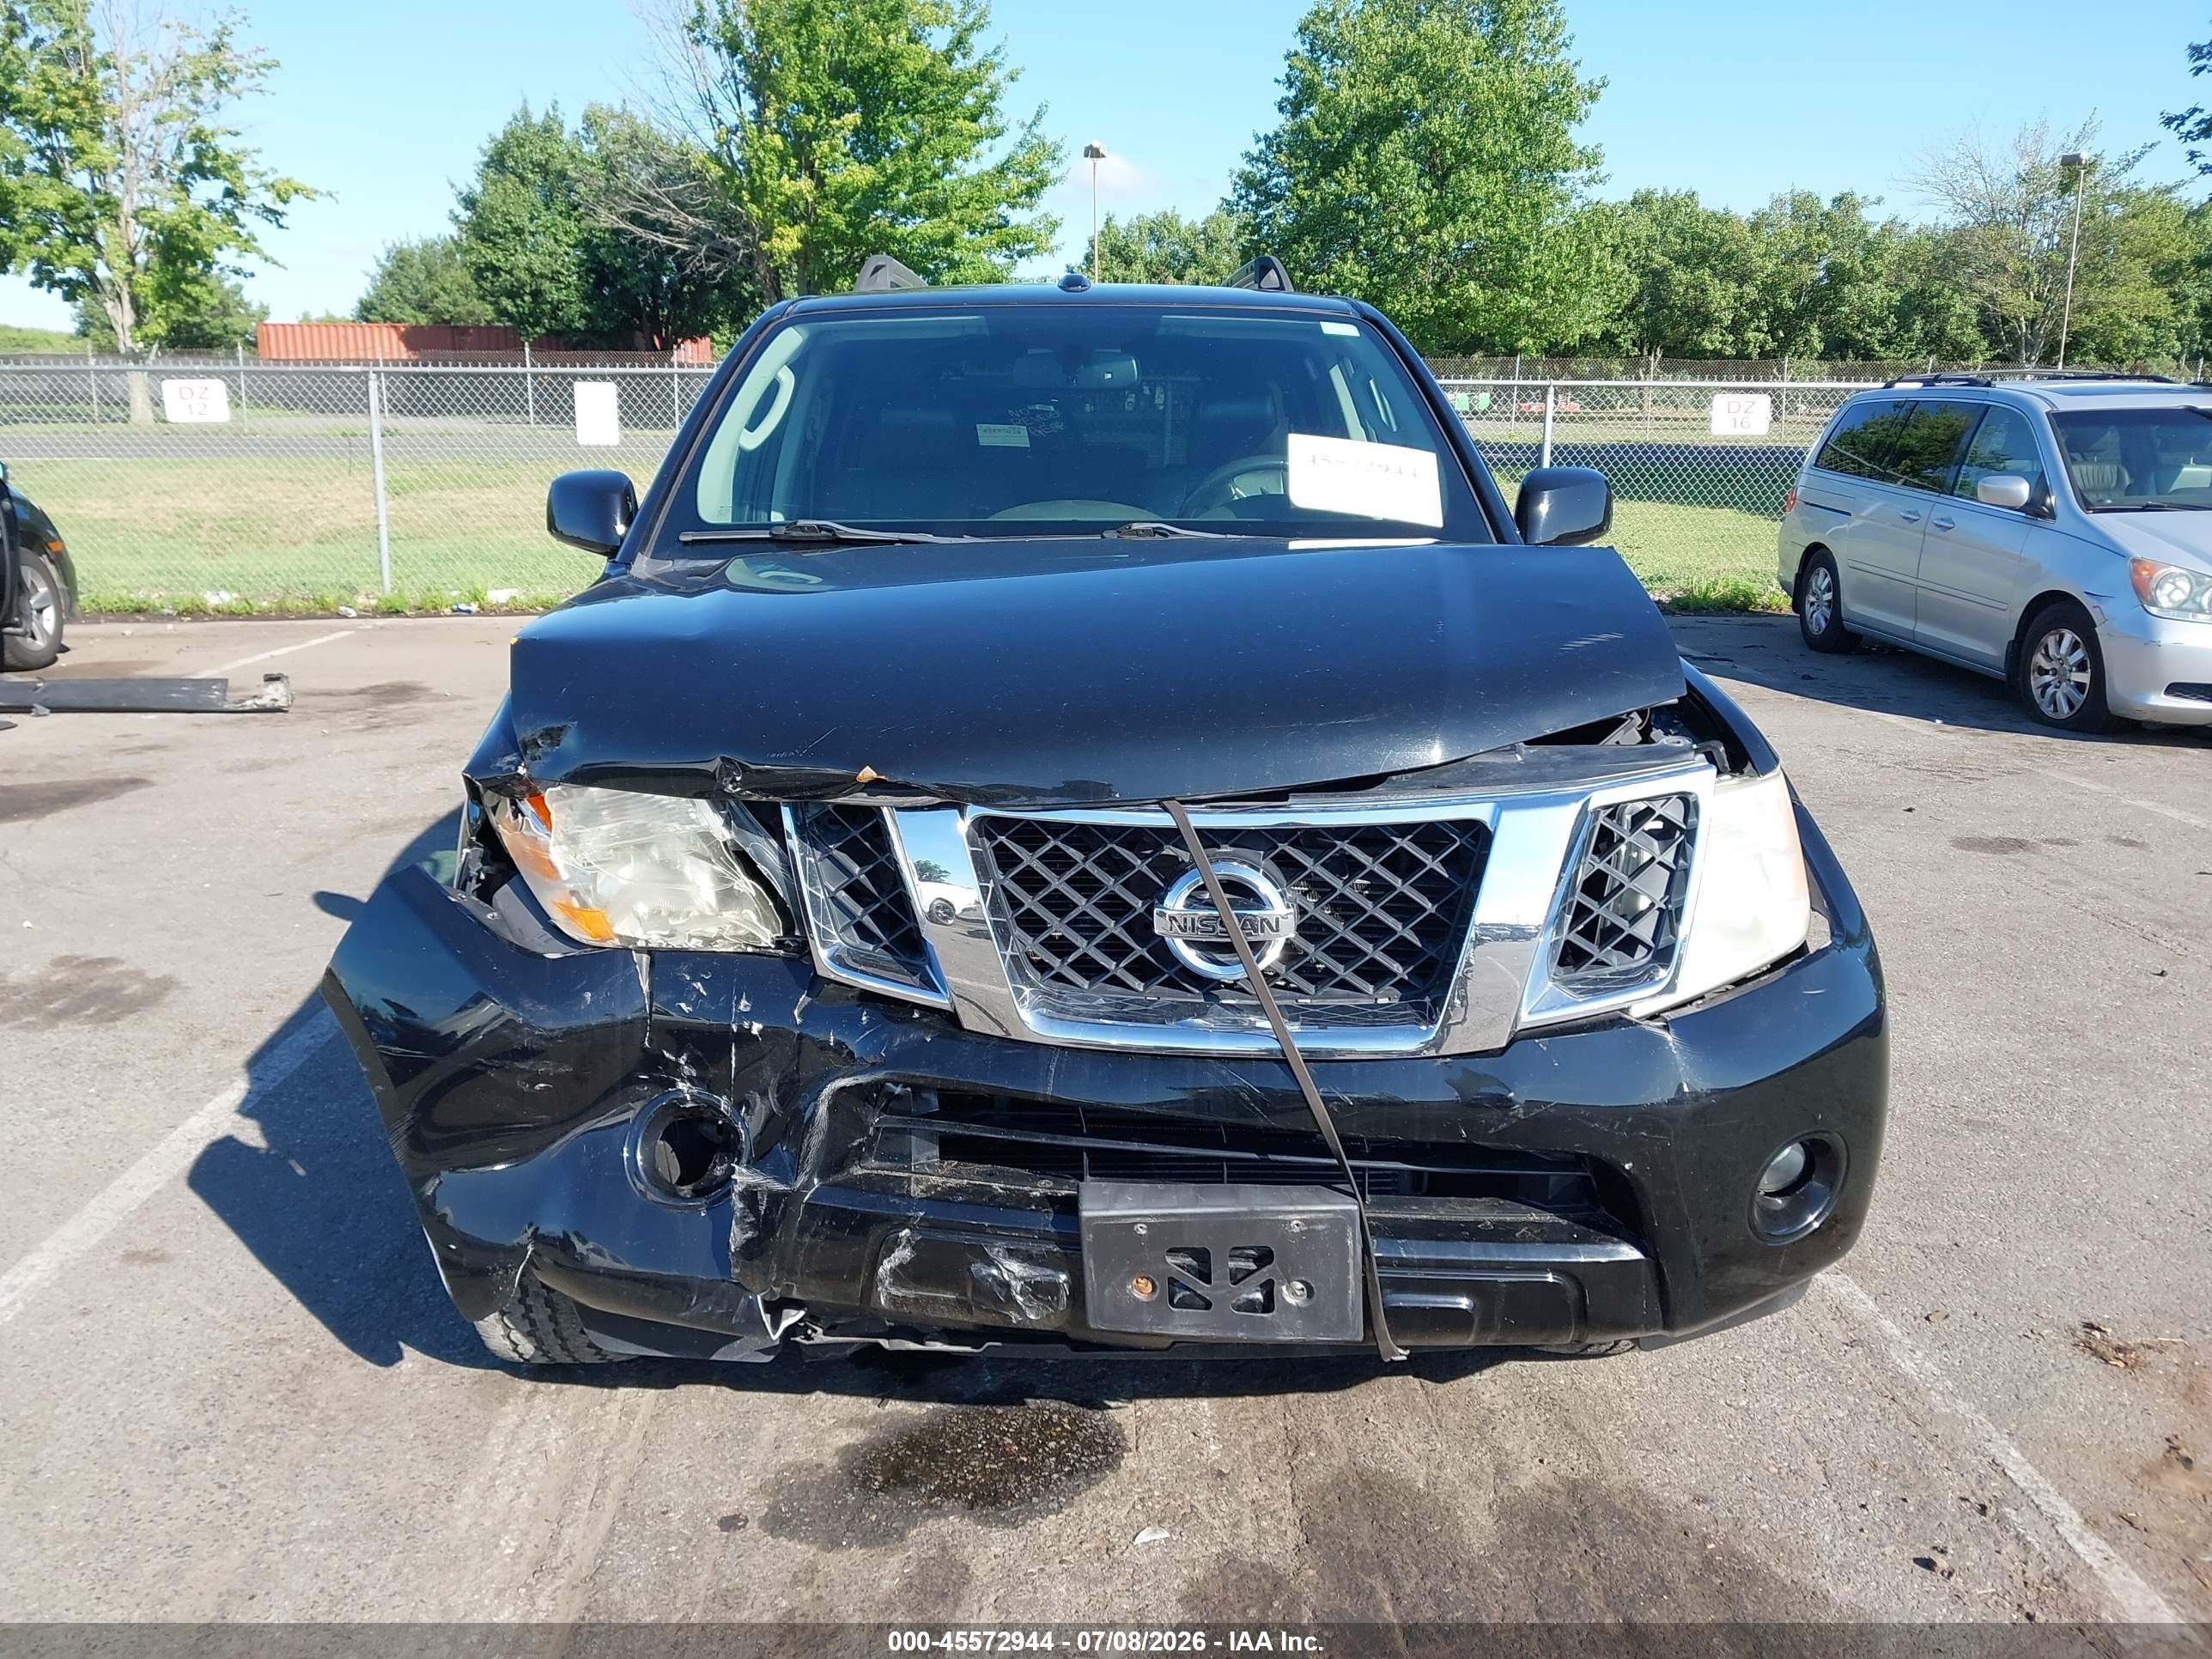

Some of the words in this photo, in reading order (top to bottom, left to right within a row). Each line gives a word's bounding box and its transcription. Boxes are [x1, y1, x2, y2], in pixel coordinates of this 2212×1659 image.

[179, 386, 210, 400] DZ
[187, 402, 207, 416] 12
[1727, 400, 1756, 414] DZ
[1732, 416, 1752, 429] 16
